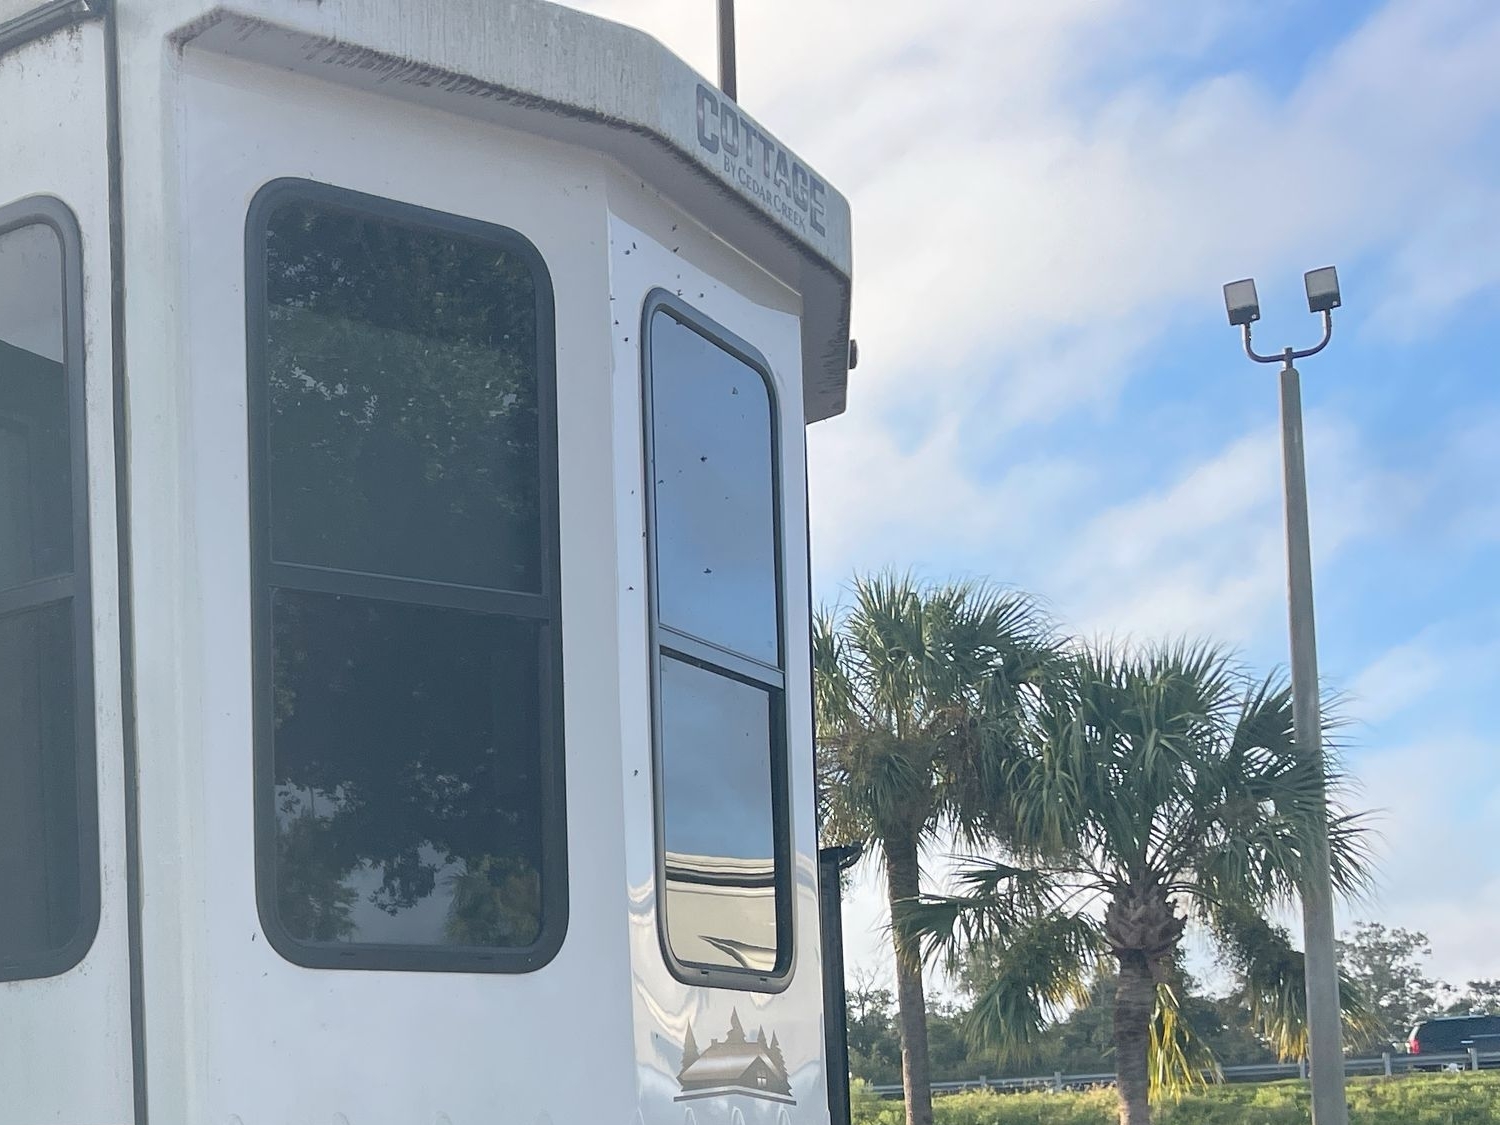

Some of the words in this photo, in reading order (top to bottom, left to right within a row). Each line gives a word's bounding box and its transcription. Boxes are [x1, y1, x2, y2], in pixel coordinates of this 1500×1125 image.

[696, 83, 826, 238] COTTAGE
[723, 155, 736, 180] BY
[738, 167, 774, 206] CEDAR
[774, 195, 806, 233] CREEK
